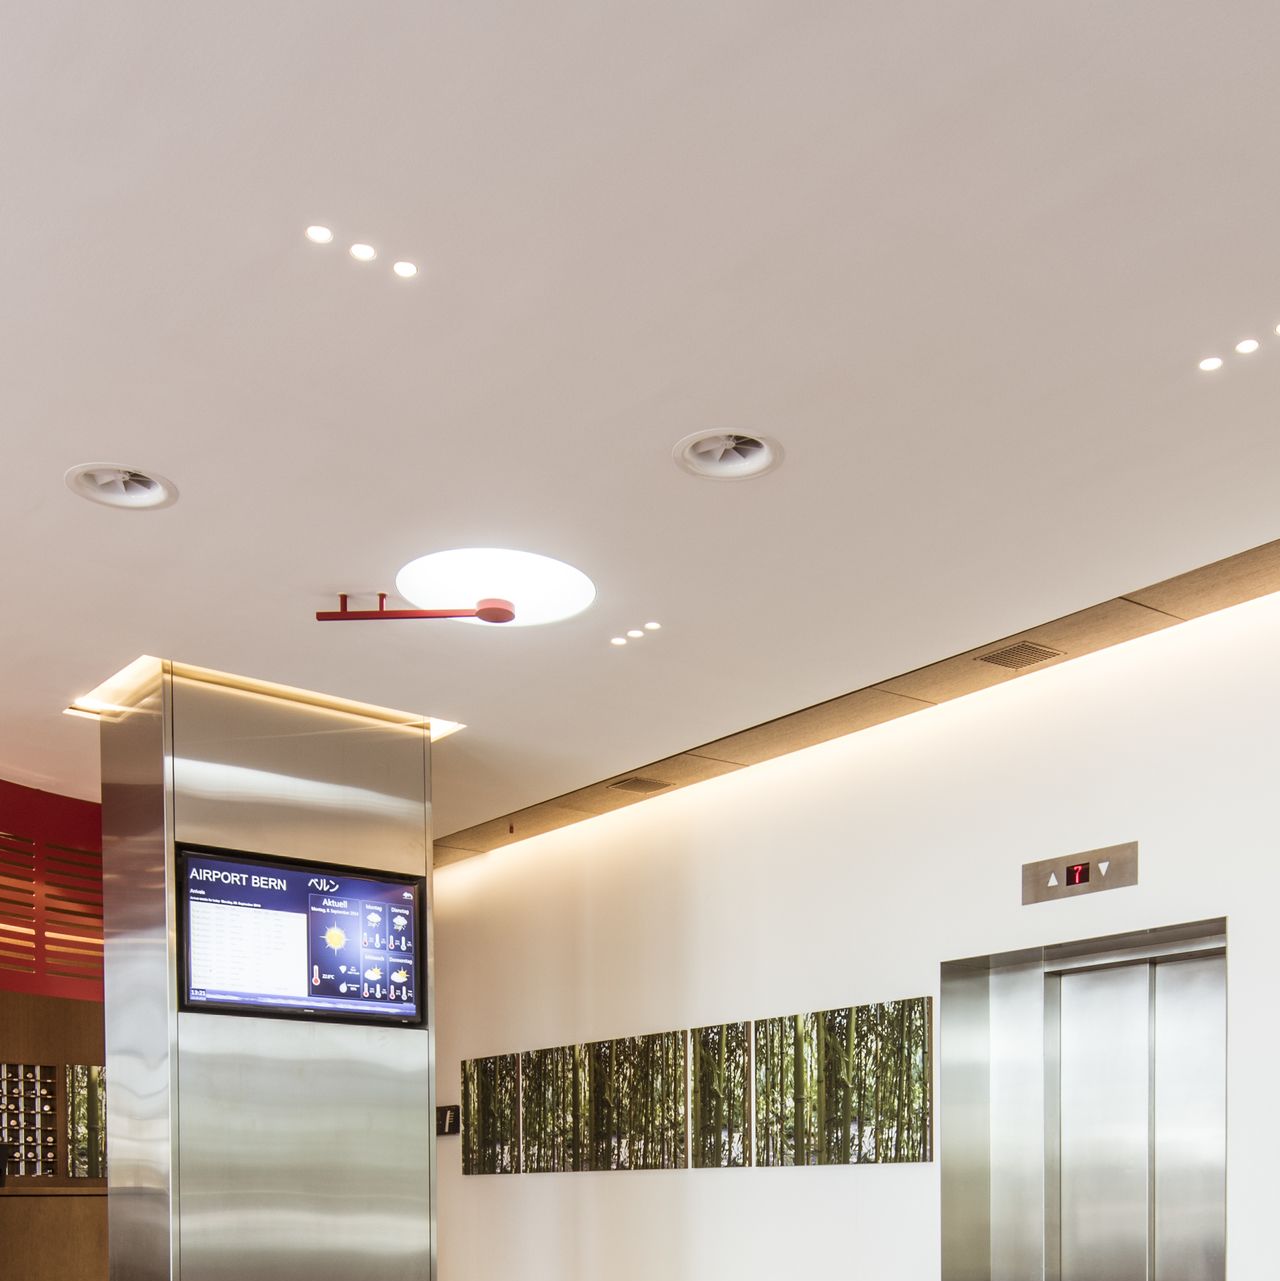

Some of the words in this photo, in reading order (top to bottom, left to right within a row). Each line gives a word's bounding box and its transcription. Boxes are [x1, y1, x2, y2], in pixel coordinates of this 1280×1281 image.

[189, 867, 249, 886] AIRPORT
[251, 875, 287, 891] BERN
[1073, 865, 1082, 883] 7
[308, 878, 339, 892] ベルン
[322, 898, 348, 908] Aktuell
